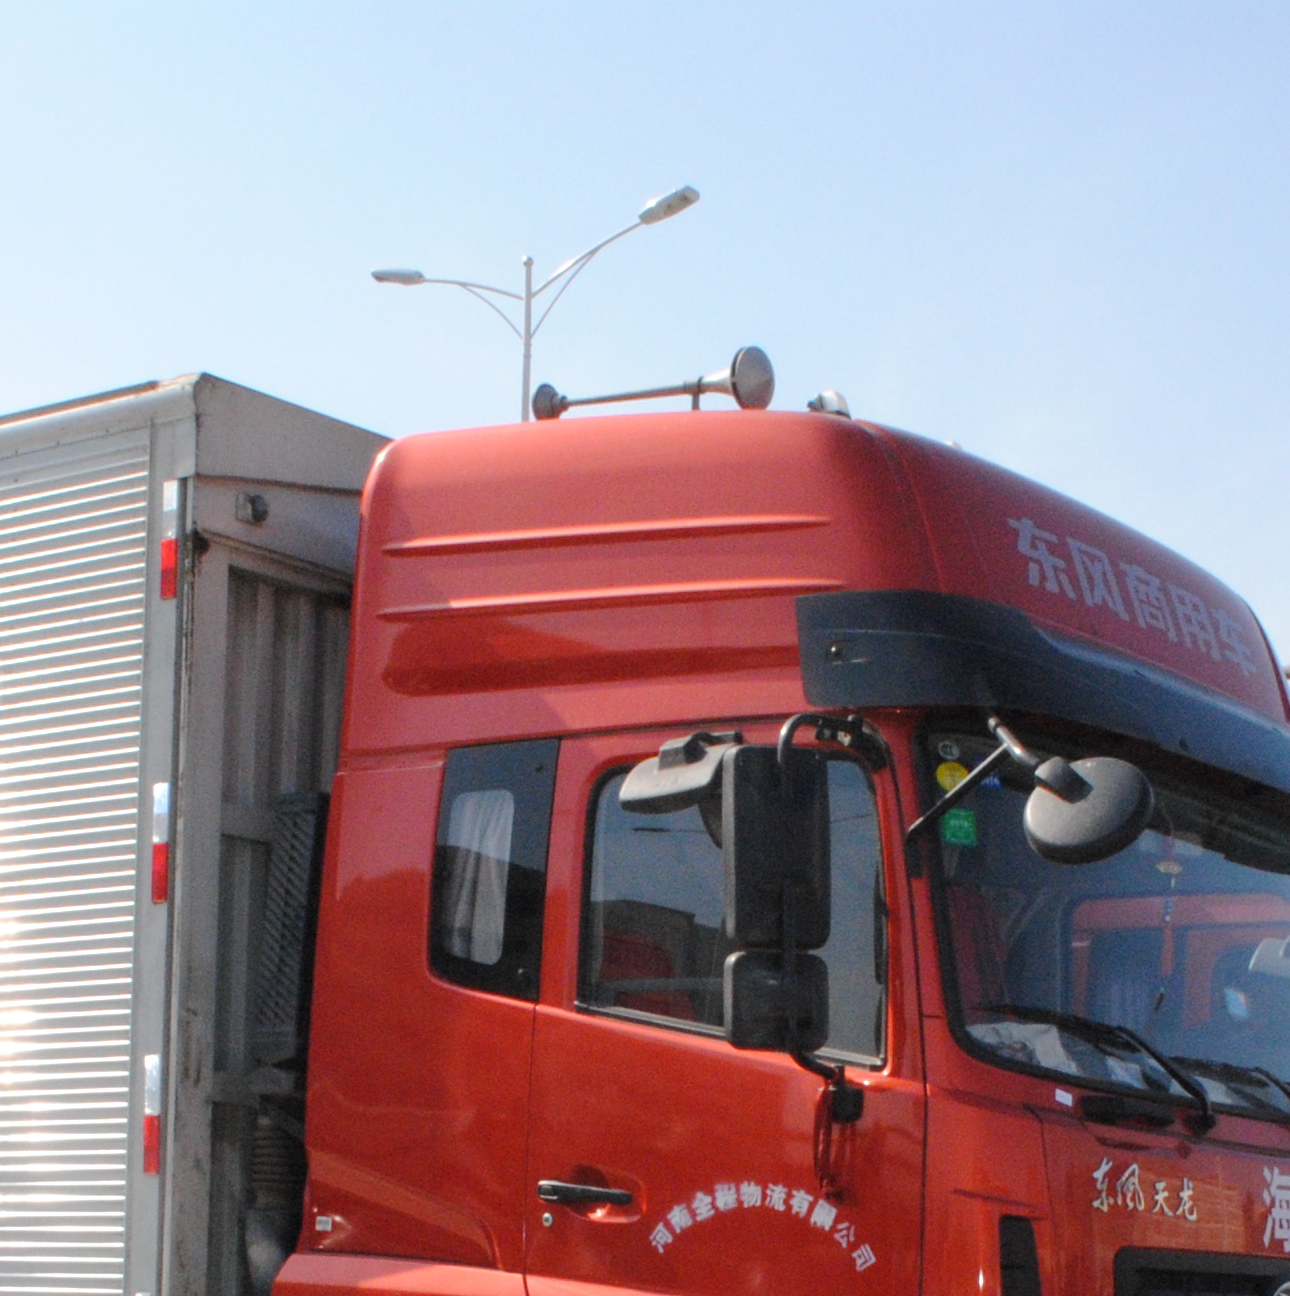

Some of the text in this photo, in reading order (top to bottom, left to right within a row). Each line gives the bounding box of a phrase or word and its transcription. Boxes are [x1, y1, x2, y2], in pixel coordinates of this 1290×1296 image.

[1008, 516, 1257, 678] 东风商用车
[649, 1180, 877, 1272] 河南全程物流有限公司
